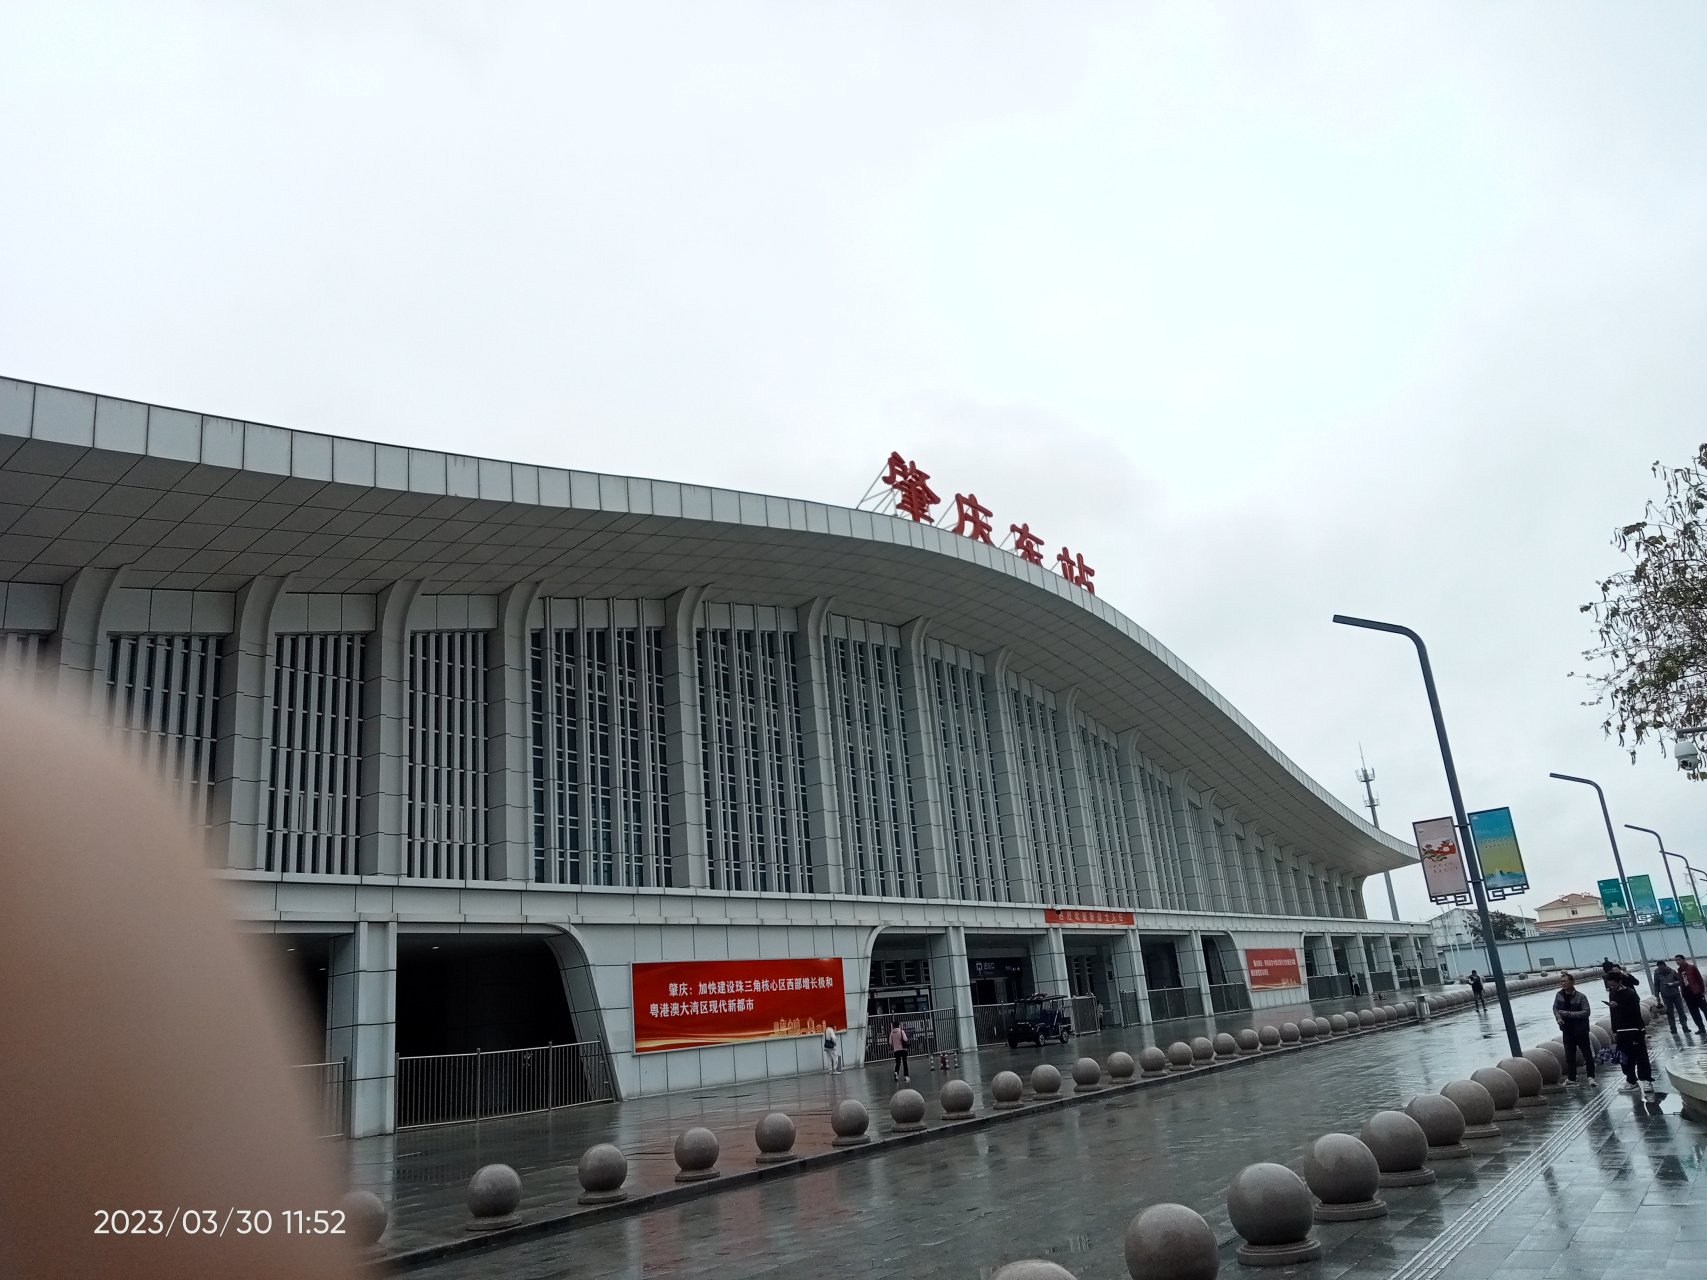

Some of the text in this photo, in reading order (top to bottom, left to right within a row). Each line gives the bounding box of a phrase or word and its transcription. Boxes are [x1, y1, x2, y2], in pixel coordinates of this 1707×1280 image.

[882, 451, 1095, 595] 肇庆东站
[650, 998, 754, 1018] 粤港澳大湾区现代新都市
